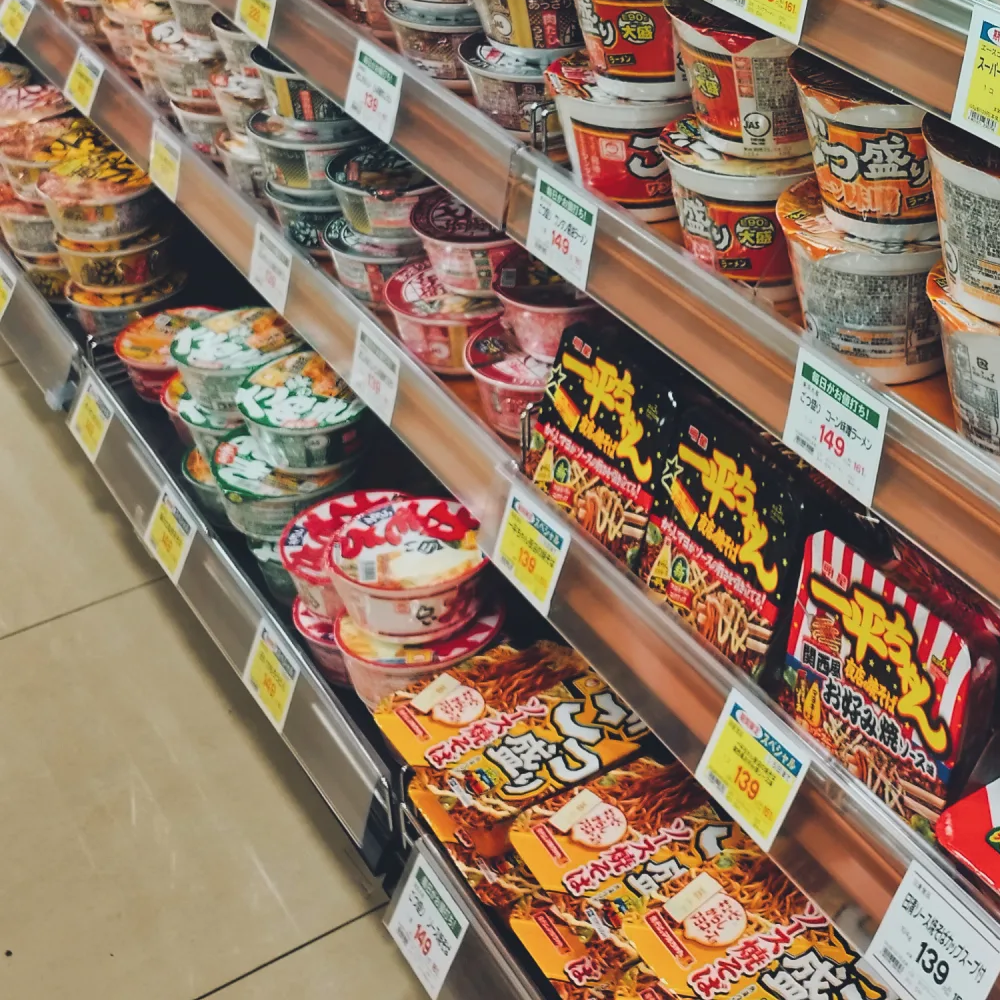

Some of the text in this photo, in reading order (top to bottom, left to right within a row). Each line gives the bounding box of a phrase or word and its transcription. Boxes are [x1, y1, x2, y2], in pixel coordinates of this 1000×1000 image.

[621, 23, 654, 42] 大盛
[608, 54, 632, 65] ラーメン
[743, 121, 761, 131] JAS
[552, 229, 570, 255] 149
[738, 228, 772, 246] 大盛
[811, 370, 871, 421] 毎日がお値打ち!
[561, 351, 653, 485] 一平ちゃん
[819, 424, 845, 457] 149
[677, 443, 779, 593] 一平ちゃん
[803, 642, 842, 680] 関西風
[809, 578, 950, 754] 一平ちゃん
[843, 656, 899, 716] 夜店の焼そば
[424, 696, 549, 769] ソース焼そば
[734, 765, 760, 801] 139
[560, 816, 692, 897] ソース焼そば
[413, 925, 432, 955] 149
[687, 900, 830, 1000] ソース焼そば
[915, 941, 949, 985] 139
